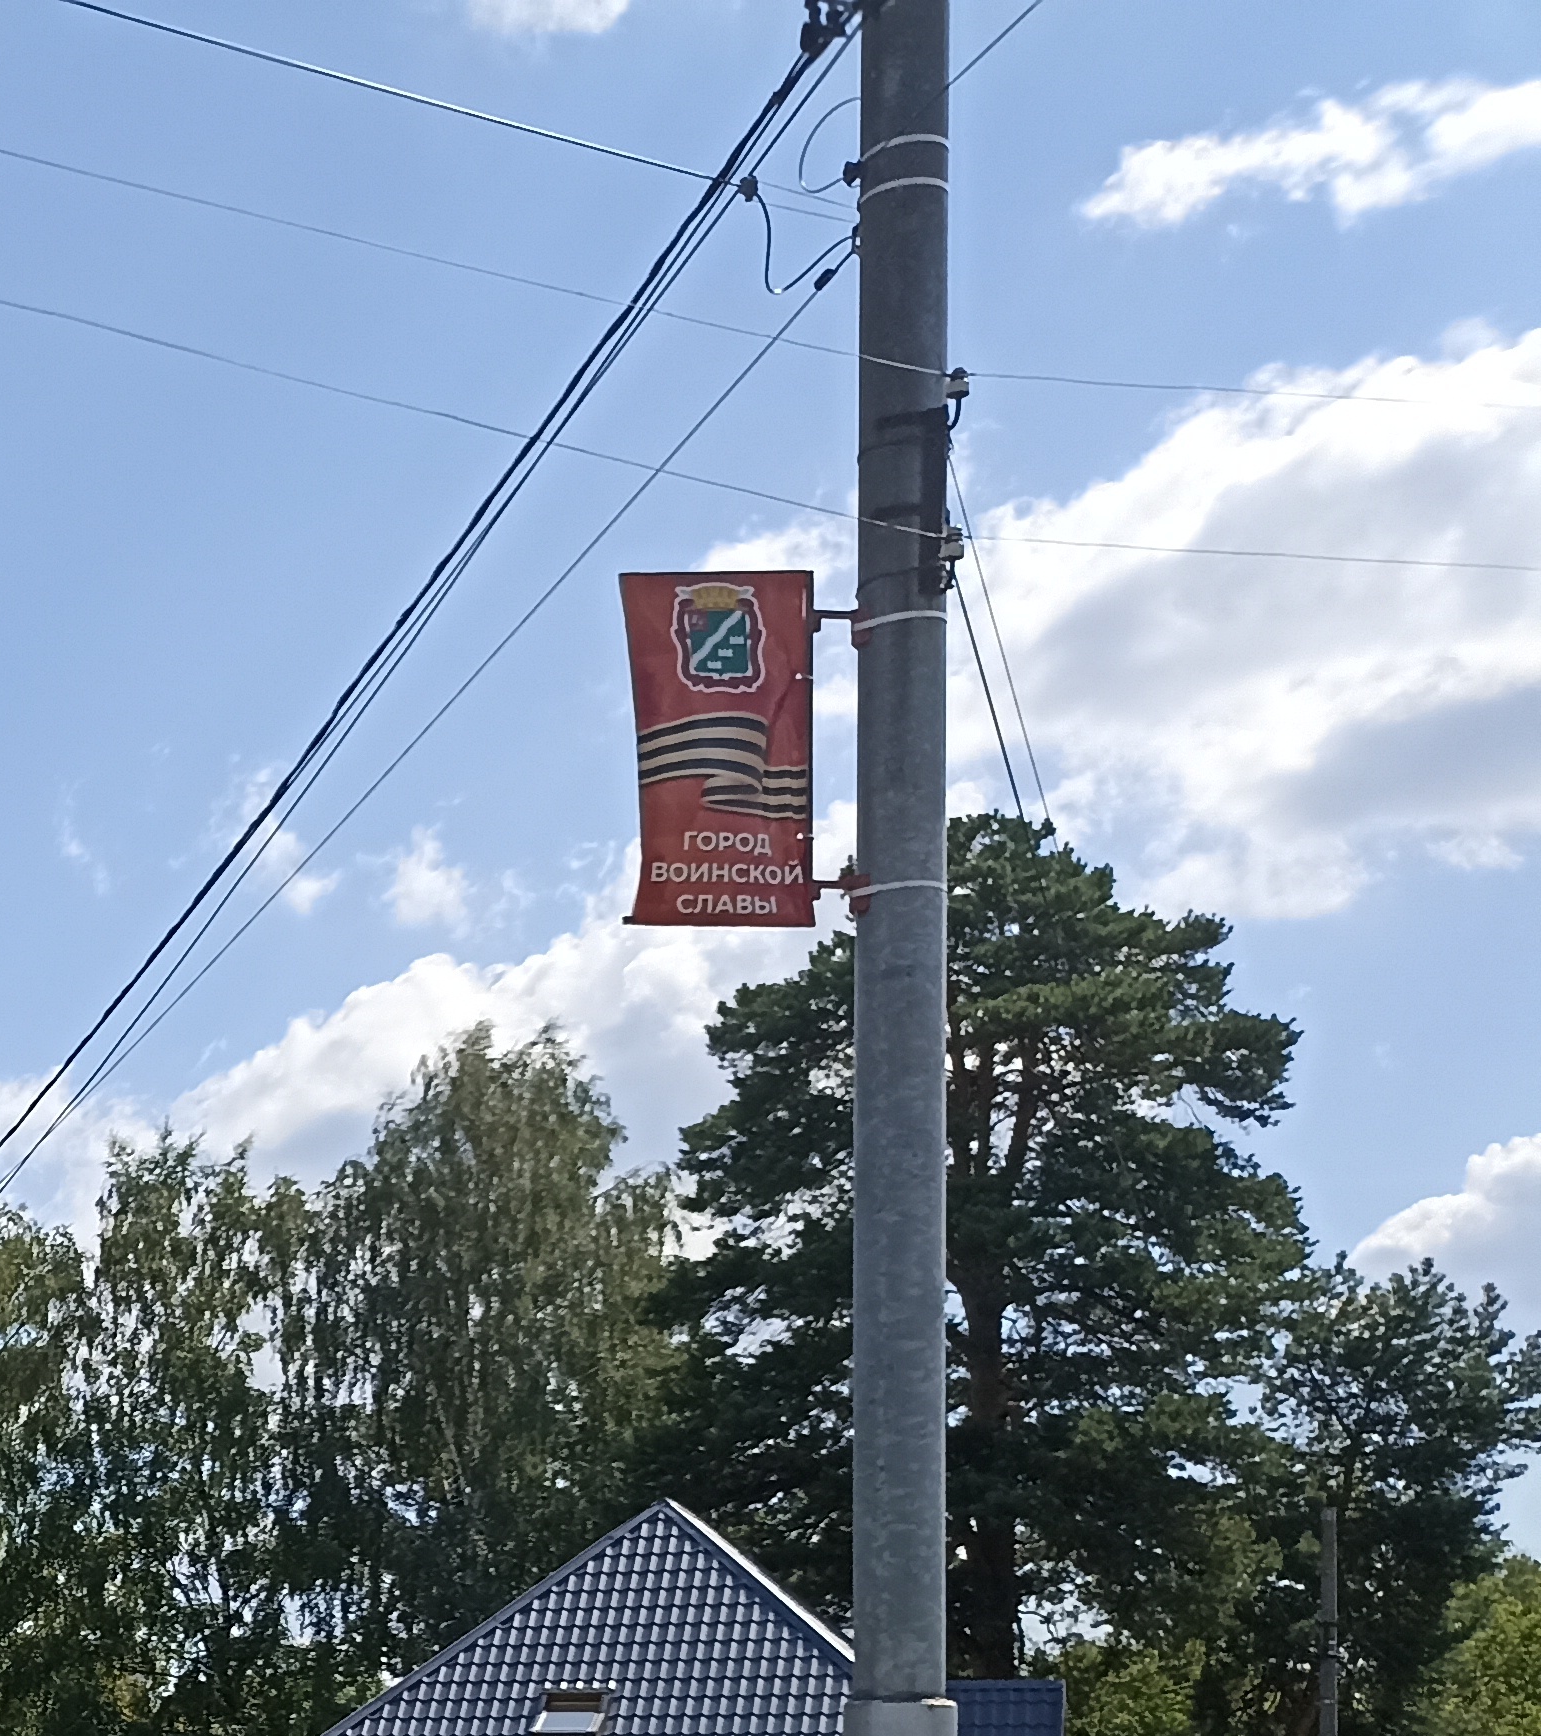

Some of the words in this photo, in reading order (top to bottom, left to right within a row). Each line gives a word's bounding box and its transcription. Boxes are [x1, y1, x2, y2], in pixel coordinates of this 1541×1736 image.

[683, 830, 772, 857] ГОРОД
[650, 860, 804, 885] ВОИНСКОЙ
[675, 894, 778, 915] СЛАВЫ
